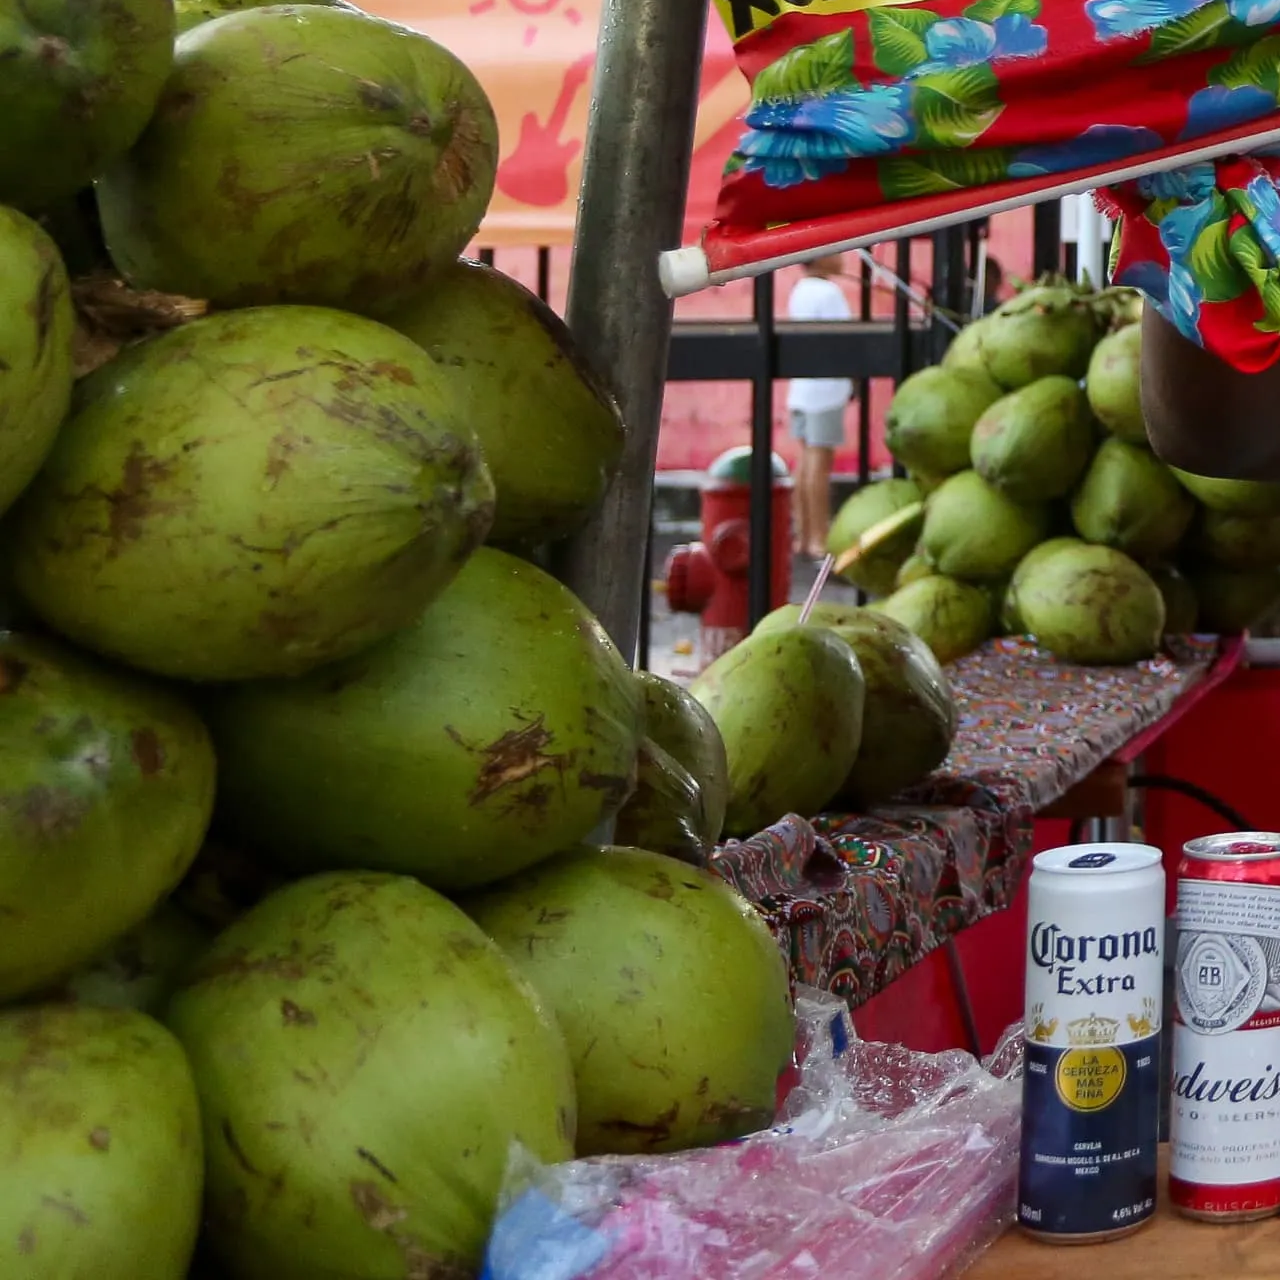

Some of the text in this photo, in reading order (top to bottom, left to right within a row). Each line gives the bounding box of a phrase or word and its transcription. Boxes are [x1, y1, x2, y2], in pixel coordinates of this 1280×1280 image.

[1057, 965, 1136, 995] Extra
[1082, 1056, 1100, 1065] LA
[1063, 1065, 1119, 1077] CERVEZA
[1075, 1088, 1104, 1099] FINA
